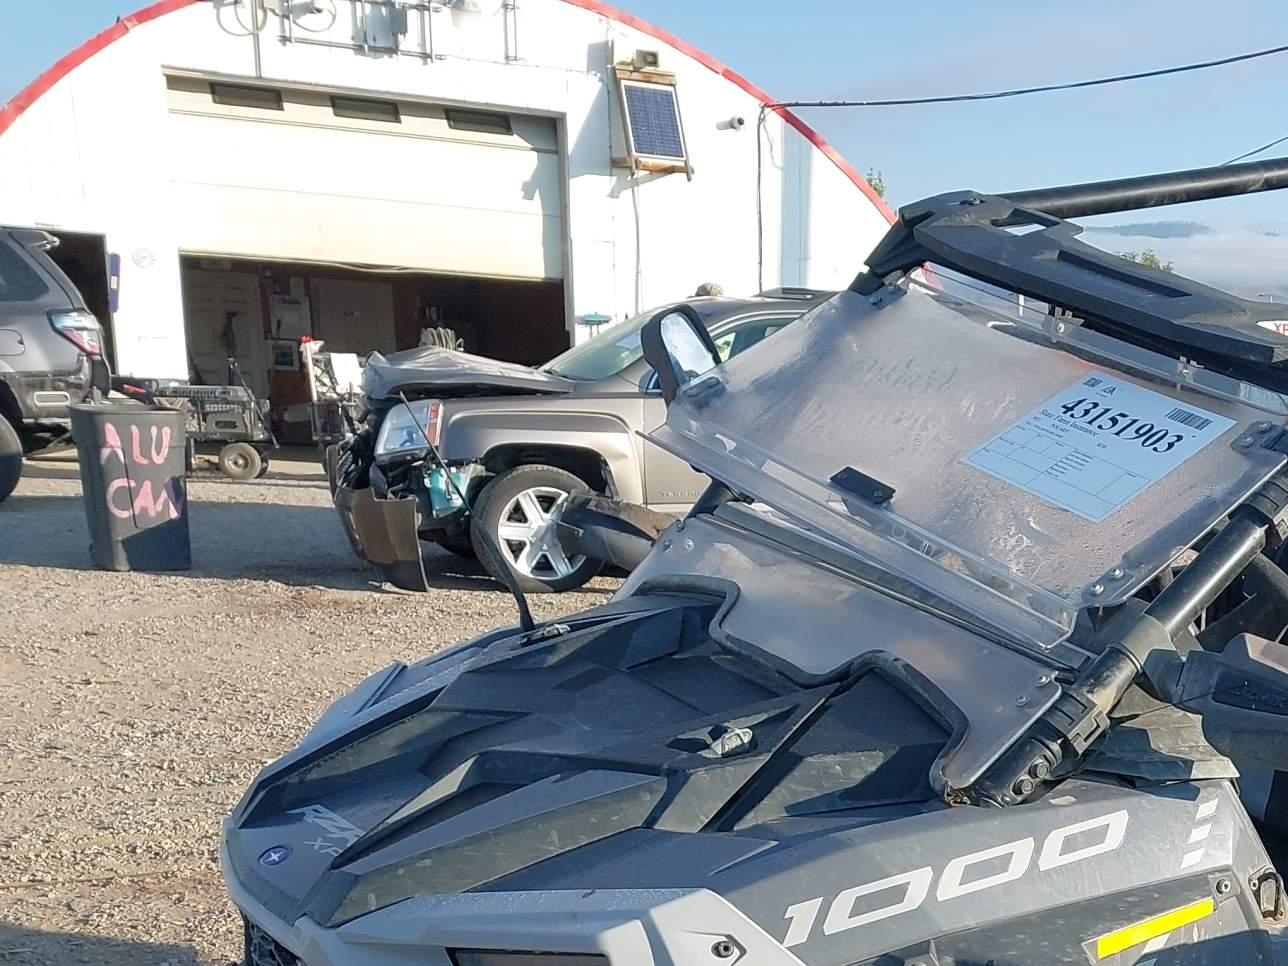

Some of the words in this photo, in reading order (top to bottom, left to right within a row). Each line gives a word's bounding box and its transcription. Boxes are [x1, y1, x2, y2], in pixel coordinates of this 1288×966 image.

[101, 422, 171, 465] ALU
[1060, 398, 1184, 453] 43151903
[106, 477, 181, 519] CAN
[782, 809, 1130, 948] 1000
